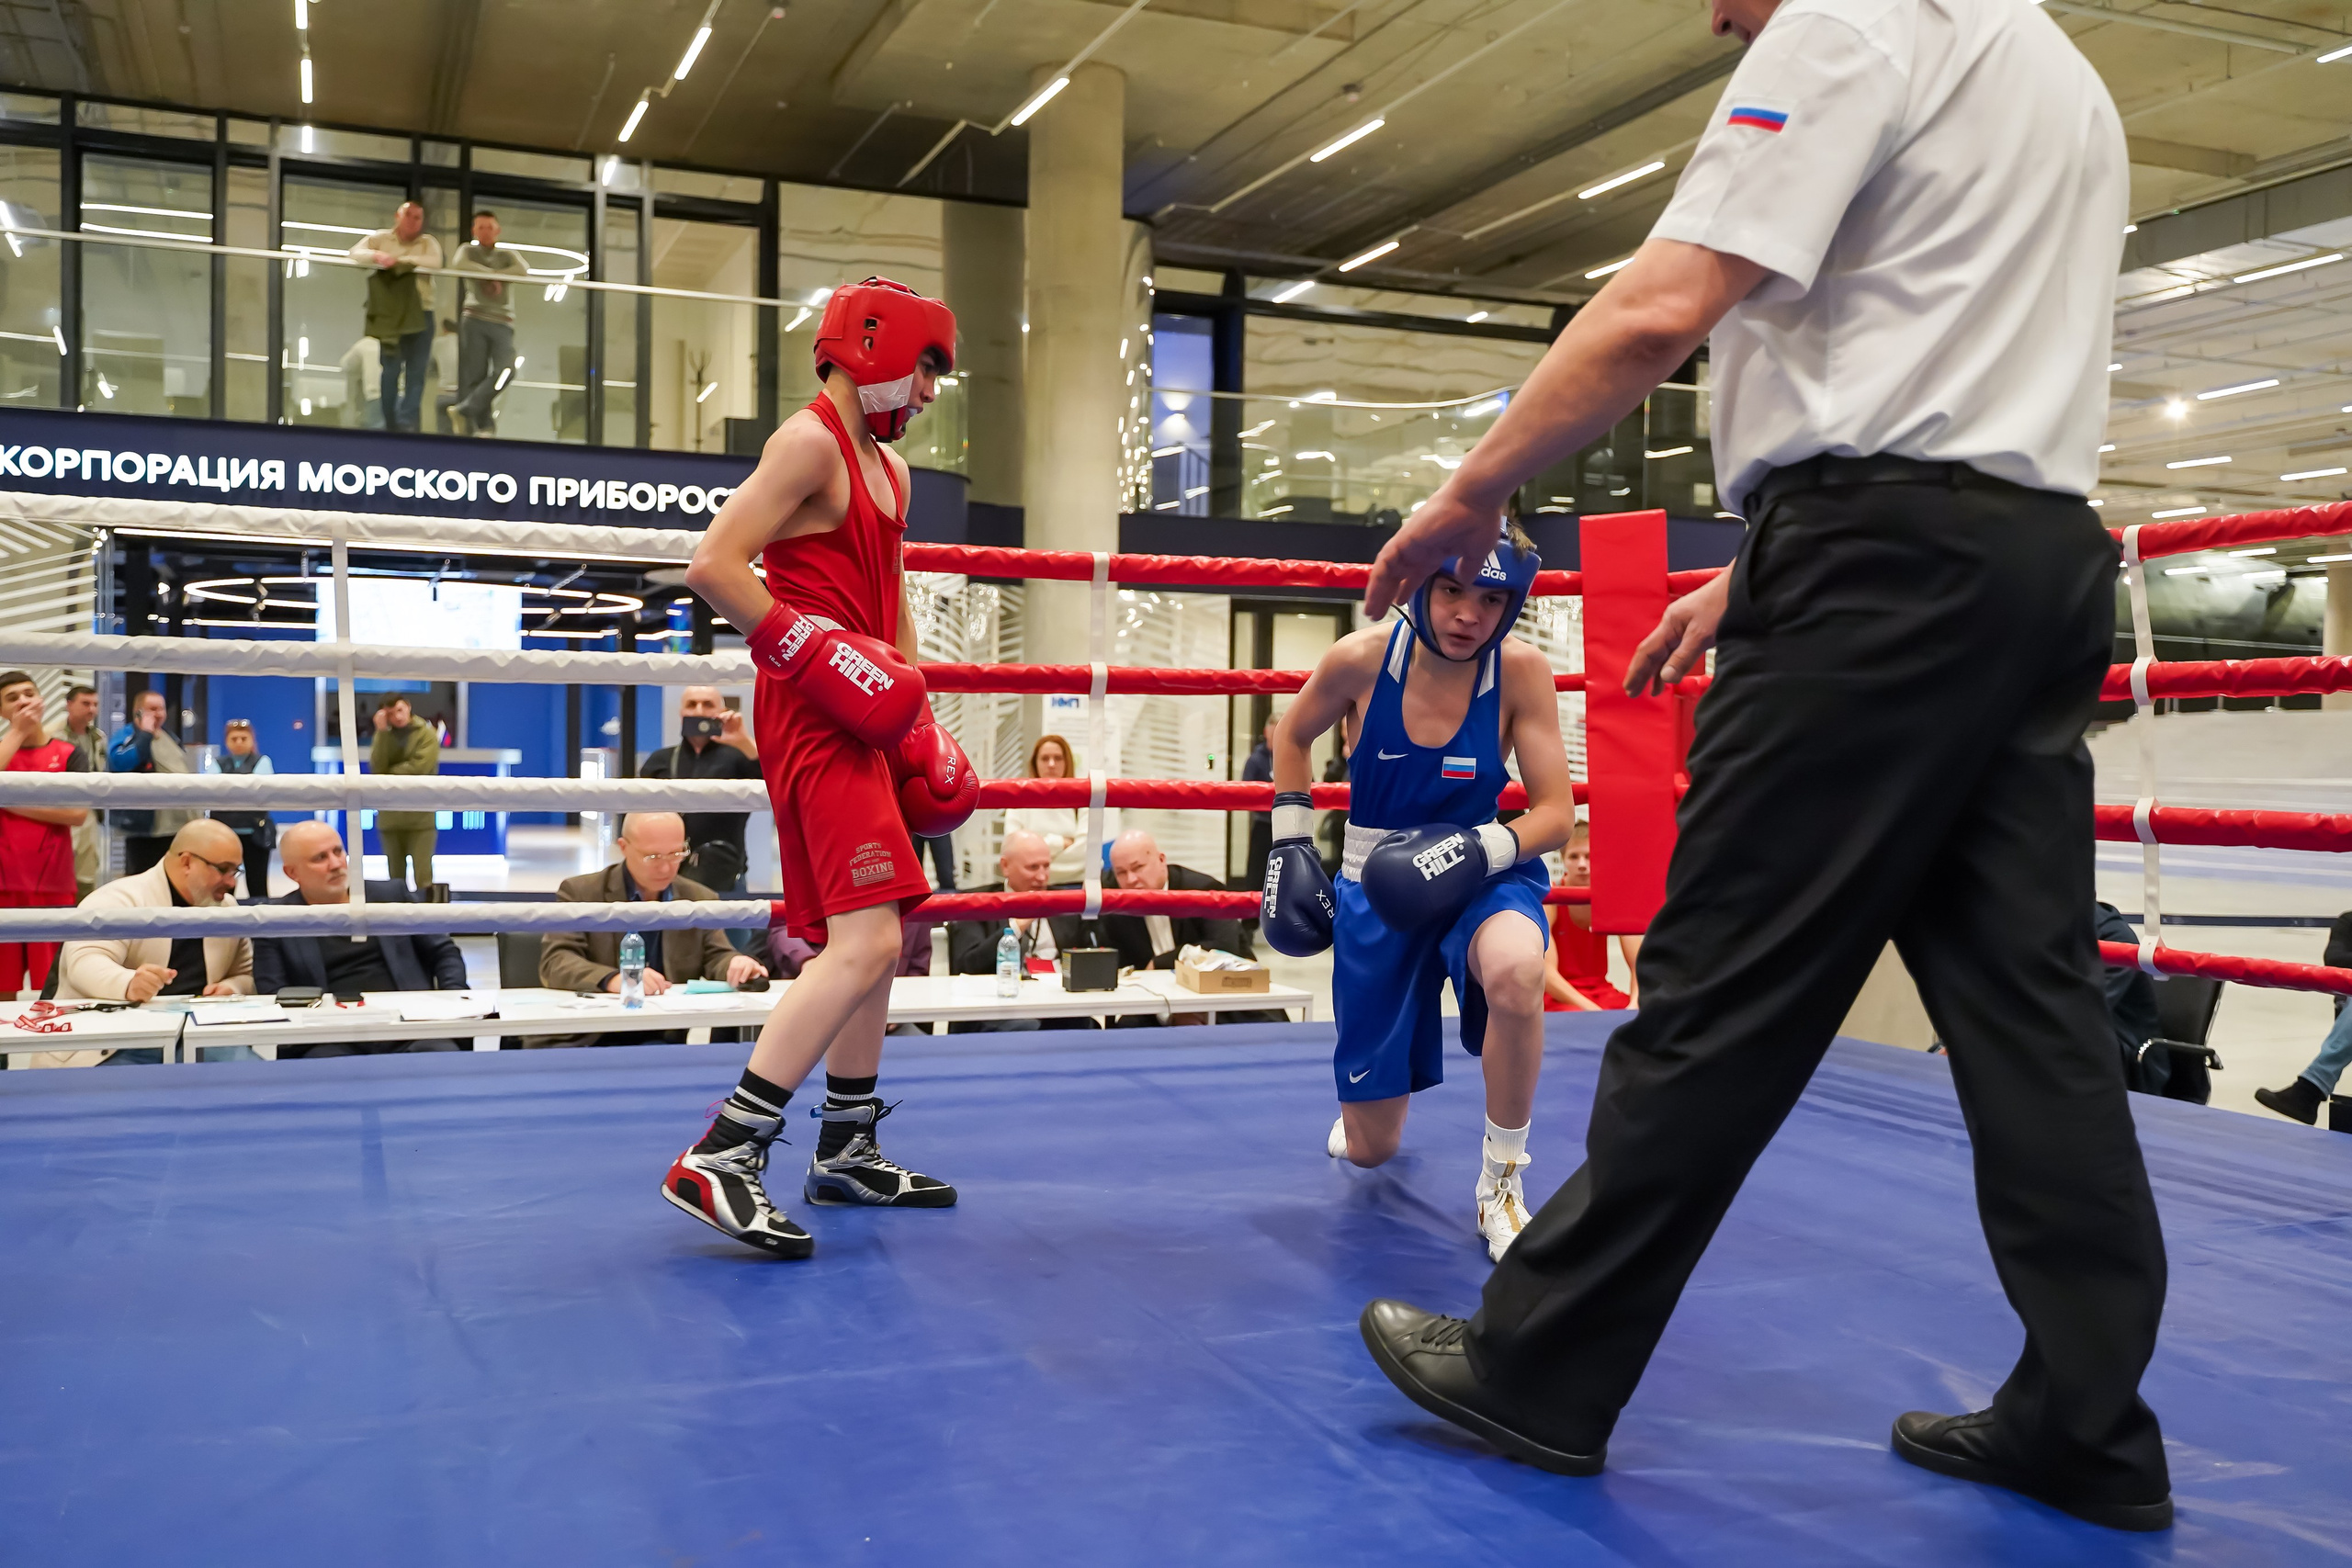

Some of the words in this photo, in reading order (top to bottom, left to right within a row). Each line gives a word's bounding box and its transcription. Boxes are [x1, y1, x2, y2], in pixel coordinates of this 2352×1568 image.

[0, 445, 285, 492] КОРПОРАЦИЯ
[298, 461, 517, 503] МОРСКОГО
[529, 476, 738, 515] ПРИБОРОС
[1478, 566, 1507, 581] das
[778, 615, 808, 647] HILL
[782, 622, 815, 661] GREEN
[828, 651, 875, 697] HILL
[836, 642, 895, 691] GREEN
[944, 755, 956, 785] REX
[849, 850, 891, 867] FEDERATION
[855, 841, 882, 853] SPORTS
[1412, 832, 1465, 868] GREEN
[851, 861, 894, 879] BOXING
[1419, 849, 1465, 881] HILL
[1263, 859, 1276, 909] HILL
[1269, 856, 1283, 919] GREEN
[1316, 888, 1335, 919] REX
